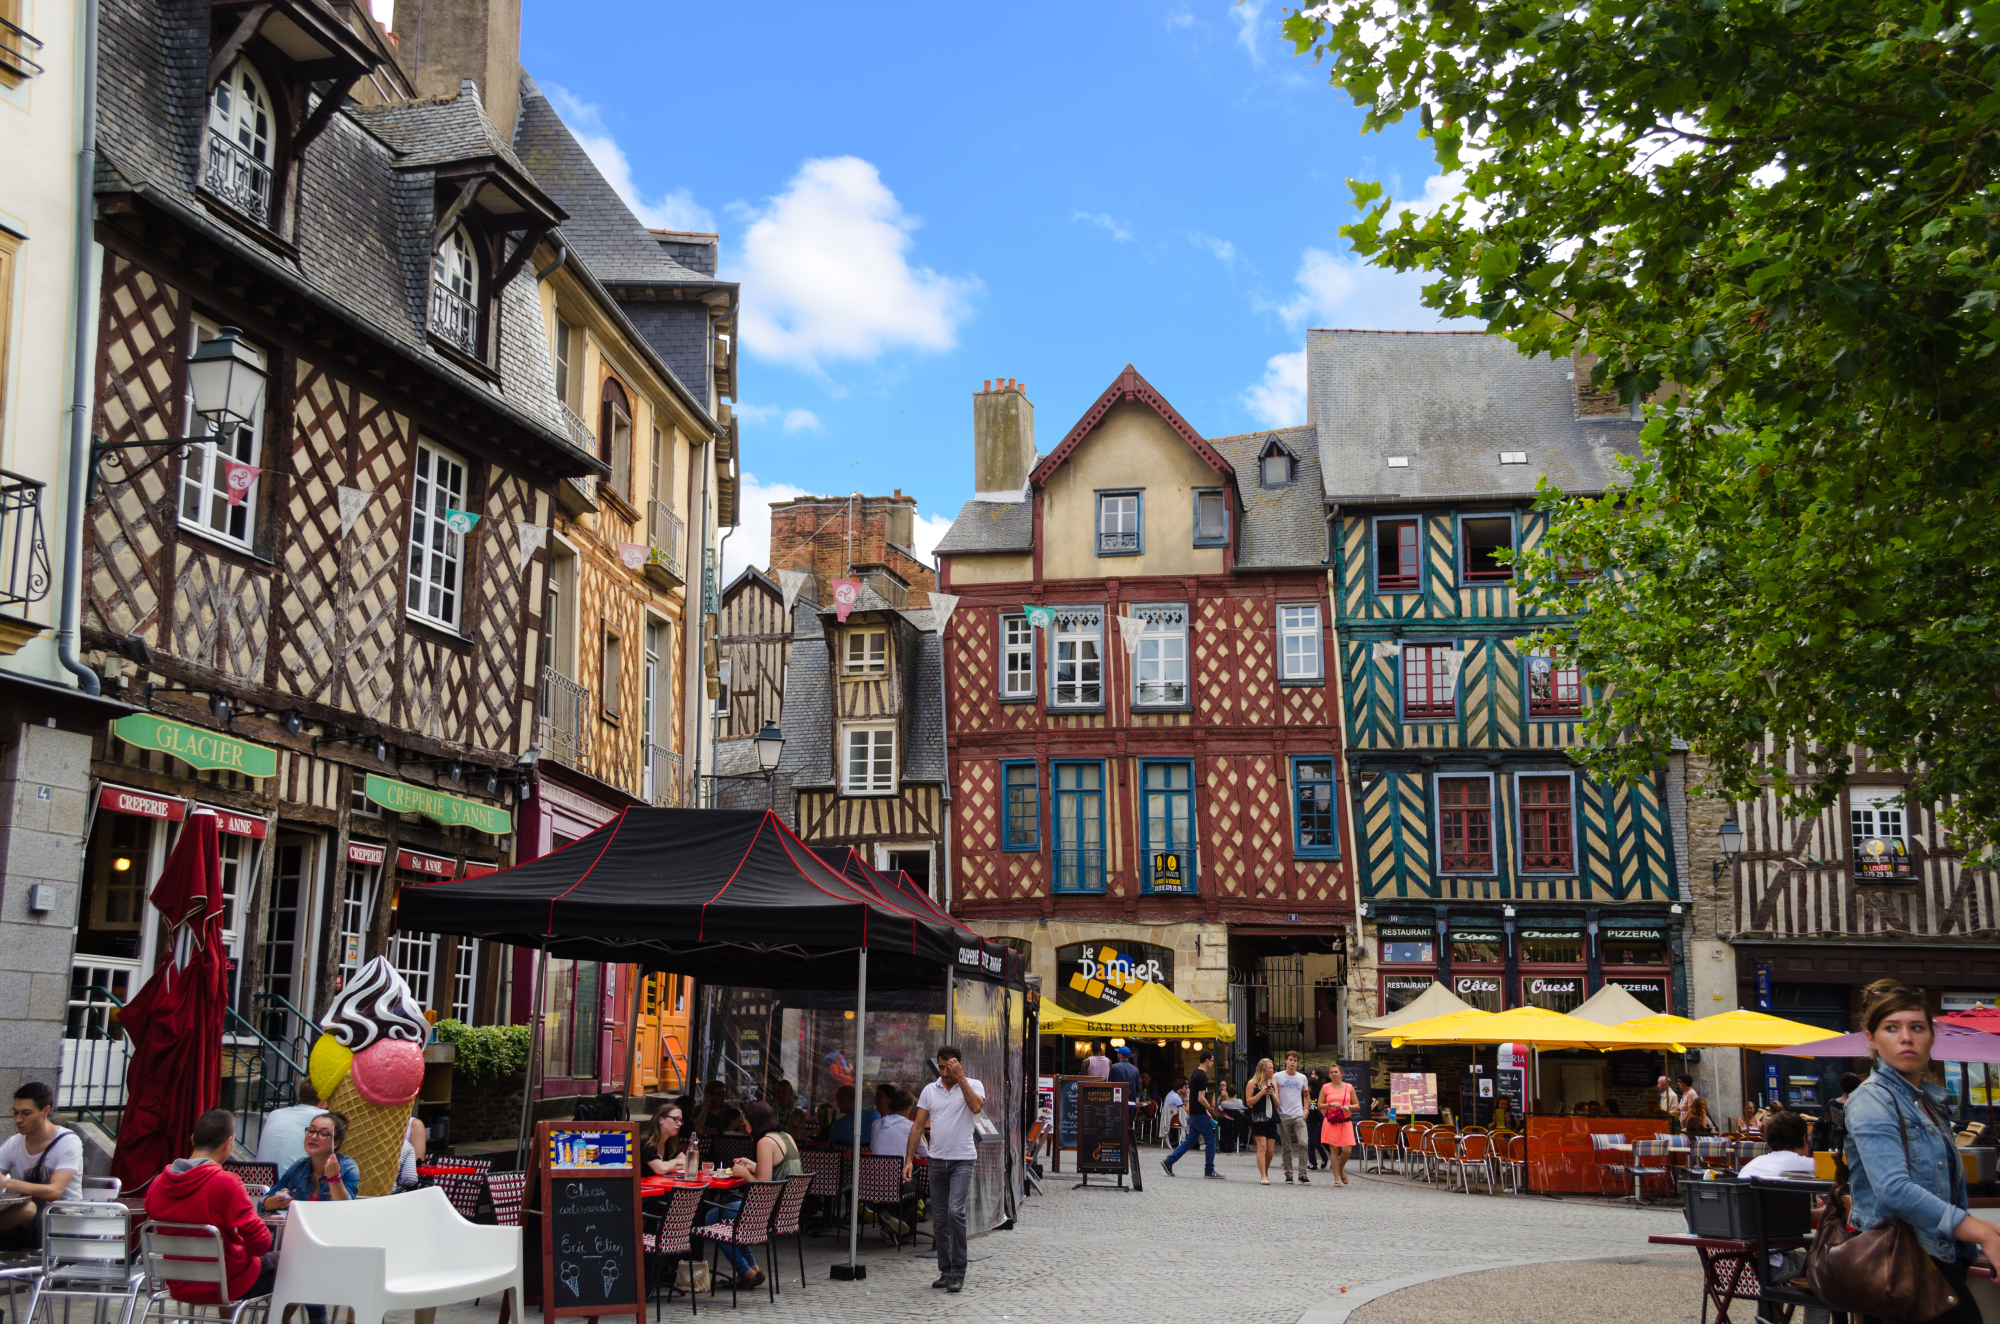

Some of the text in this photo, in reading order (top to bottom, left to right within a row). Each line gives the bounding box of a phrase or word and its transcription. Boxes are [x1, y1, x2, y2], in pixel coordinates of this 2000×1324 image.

[156, 724, 244, 768] GLACIER
[40, 786, 48, 800] 4
[119, 793, 169, 817] CREPERIE
[387, 784, 444, 816] CREPERIE
[462, 806, 494, 829] ANNE
[228, 817, 252, 834] ANNE
[349, 846, 384, 864] CREPERIE
[412, 856, 442, 874] Ste ANNE
[1390, 915, 1398, 923] 10
[1382, 928, 1432, 936] RESTAURANT
[1453, 932, 1498, 940] Côte
[1521, 930, 1581, 938] Ouest
[1607, 930, 1660, 938] PIZZERIA
[1082, 944, 1094, 959] le
[1104, 986, 1117, 996] BAR
[1457, 979, 1498, 994] Côte
[1530, 979, 1576, 994] Ouest
[1087, 1022, 1194, 1034] BAR BRASSERIE
[566, 1183, 607, 1199] Glaces
[560, 1198, 623, 1215] artisanales
[561, 1233, 587, 1254] Eric
